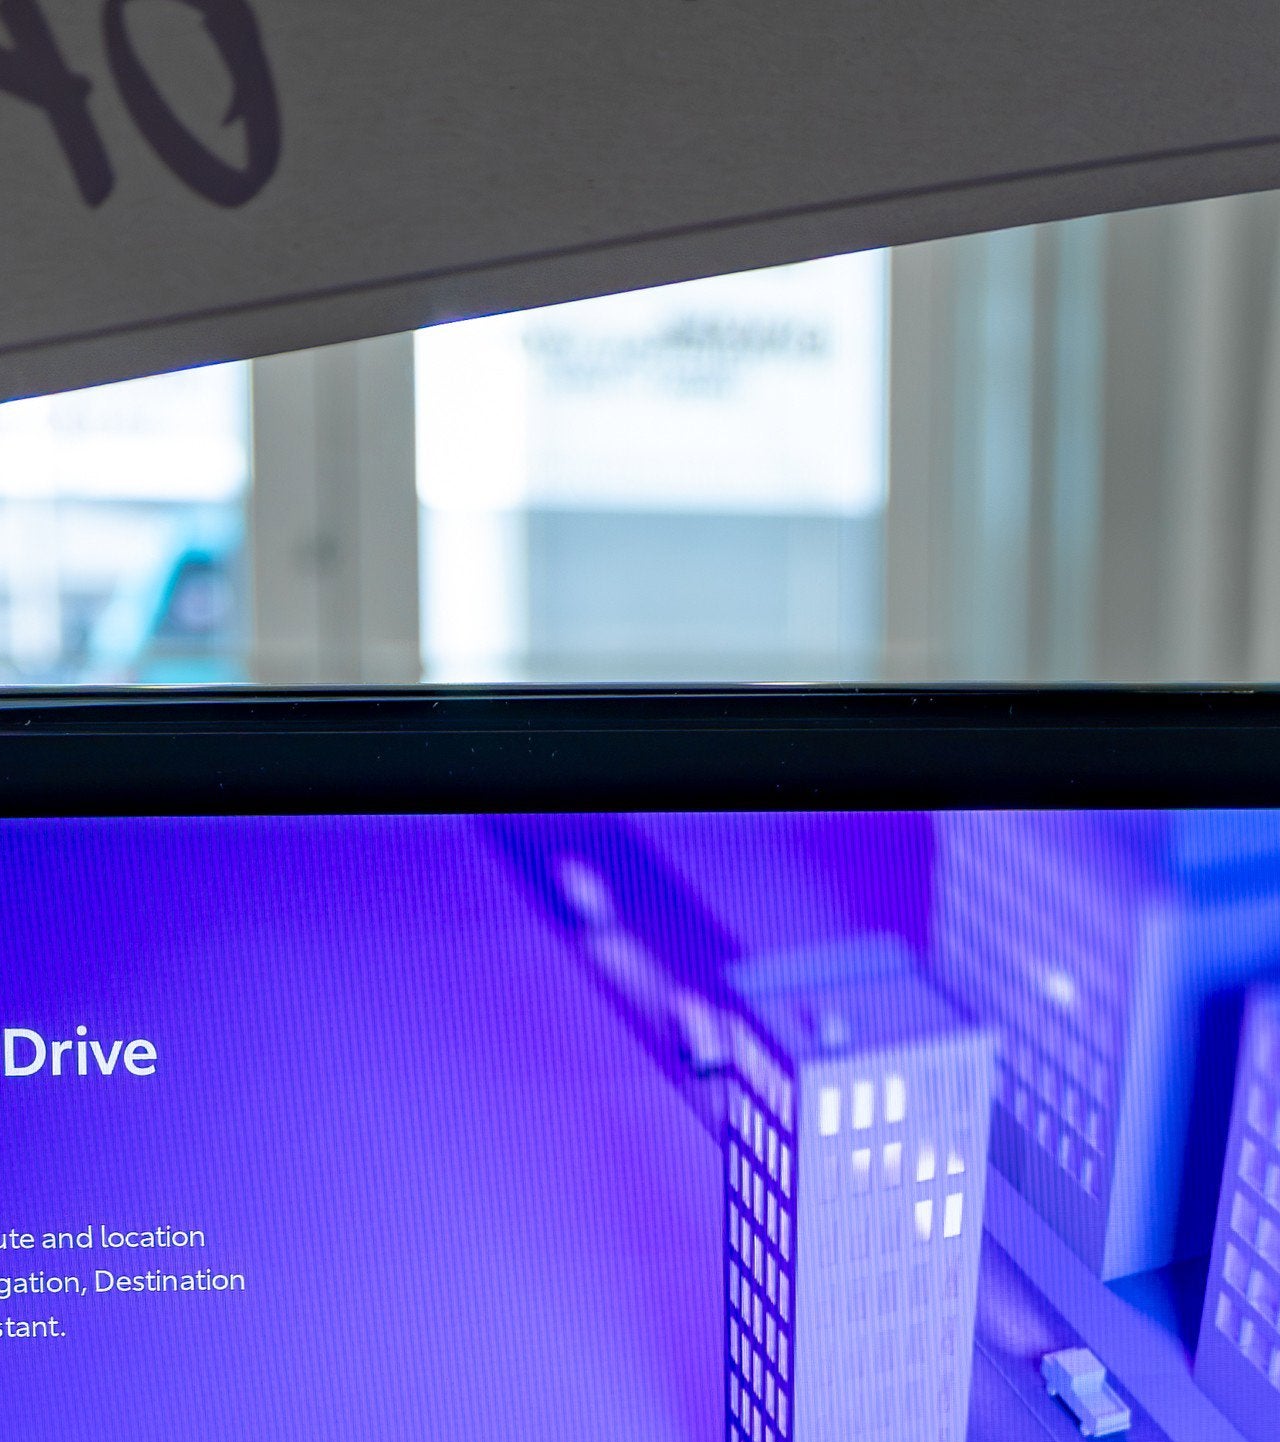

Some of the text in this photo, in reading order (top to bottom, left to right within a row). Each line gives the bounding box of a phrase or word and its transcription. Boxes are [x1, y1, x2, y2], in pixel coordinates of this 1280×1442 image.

[4, 1025, 158, 1078] Drive
[42, 1224, 93, 1250] and
[101, 1224, 206, 1249] location
[95, 1268, 246, 1293] Destination
